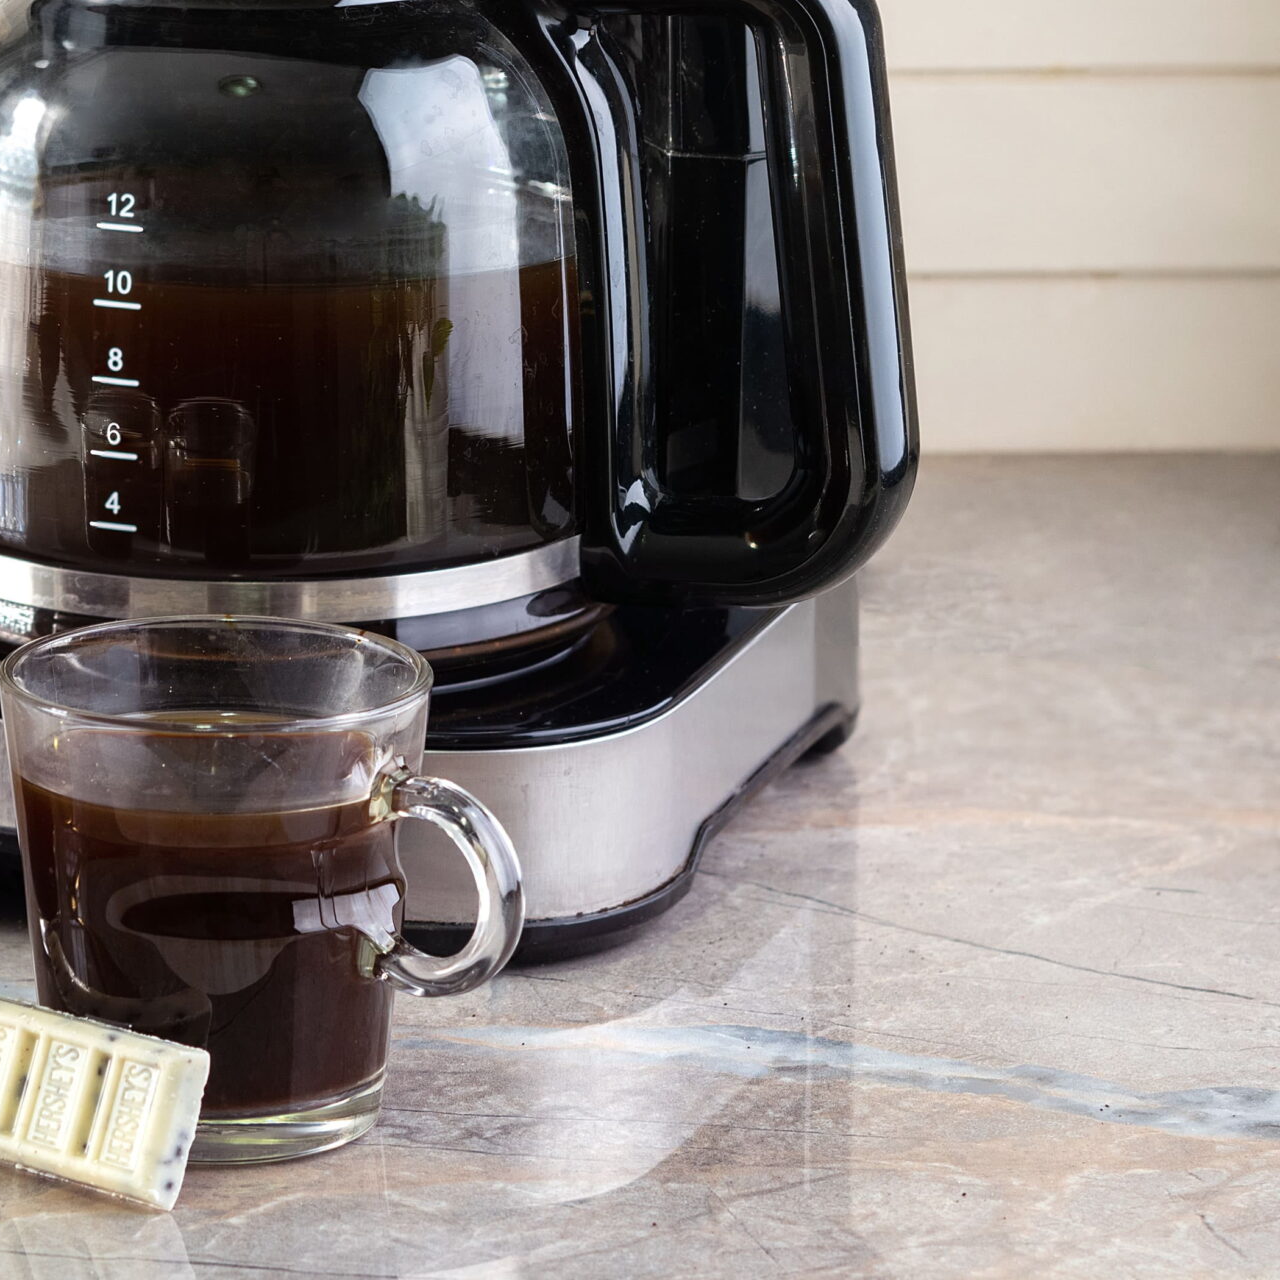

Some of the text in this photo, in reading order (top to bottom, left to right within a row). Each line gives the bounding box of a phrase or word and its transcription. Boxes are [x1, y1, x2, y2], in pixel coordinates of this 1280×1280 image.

[106, 192, 136, 218] 12
[103, 270, 132, 295] 10
[107, 347, 123, 372] 8
[105, 421, 121, 446] 6
[104, 490, 121, 515] 4
